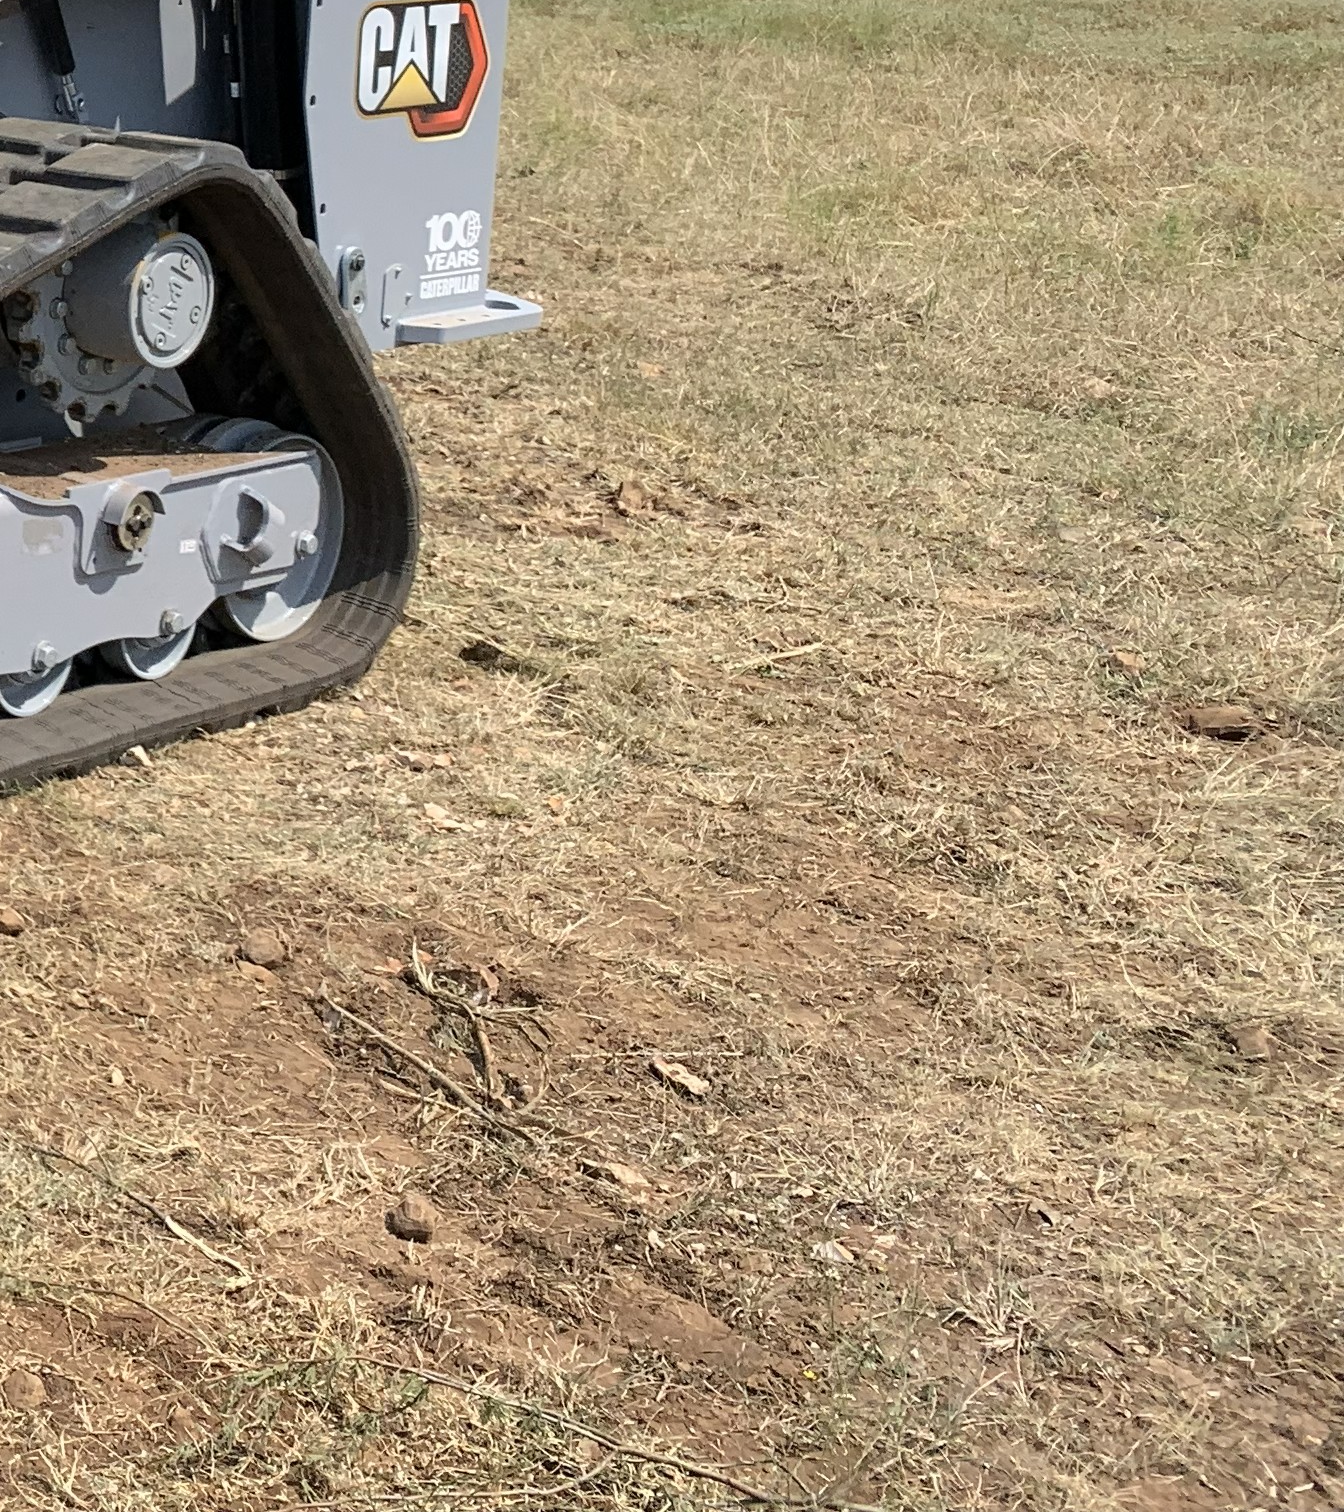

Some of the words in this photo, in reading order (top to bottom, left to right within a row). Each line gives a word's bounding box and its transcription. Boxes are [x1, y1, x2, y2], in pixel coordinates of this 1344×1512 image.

[358, 3, 461, 112] CAT
[425, 209, 483, 253] 100
[424, 247, 480, 273] YEARS
[420, 273, 480, 299] CATERPILLAR
